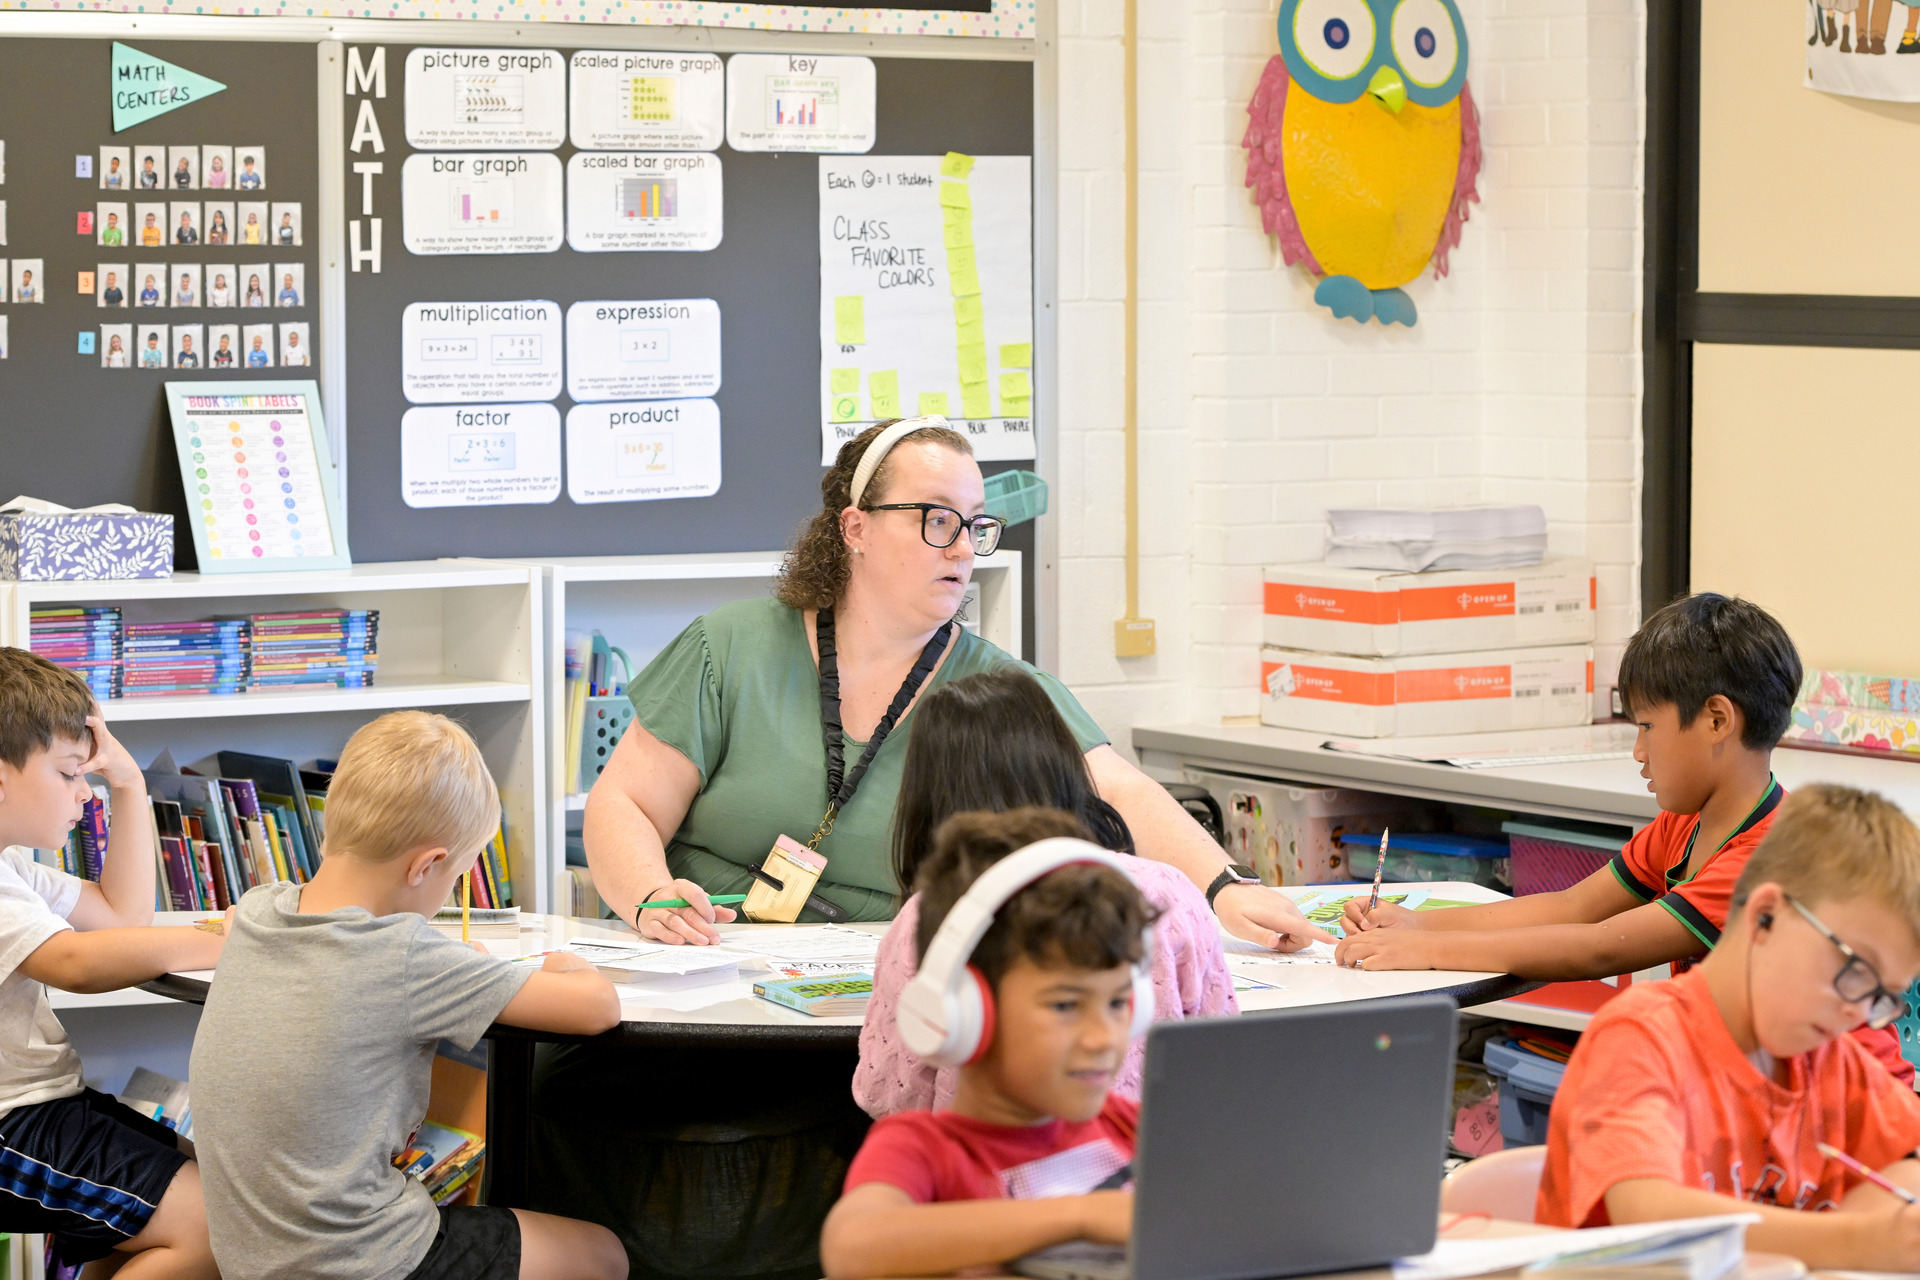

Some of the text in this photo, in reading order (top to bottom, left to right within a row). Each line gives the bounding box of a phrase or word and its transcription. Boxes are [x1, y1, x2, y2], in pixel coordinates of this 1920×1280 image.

[423, 52, 552, 73] picture graph
[574, 55, 721, 73] scaled picture graph
[789, 54, 817, 75] key
[118, 65, 166, 81] MATH
[117, 86, 190, 110] CENTERS
[346, 46, 386, 273] MATH
[433, 156, 527, 175] bar graph
[582, 156, 704, 172] scaled bar graph
[828, 172, 856, 189] Each
[887, 175, 890, 185] 1
[898, 172, 933, 187] student
[82, 218, 88, 228] 2
[834, 216, 890, 242] CLASS
[852, 246, 925, 269] FAVORITE
[83, 277, 89, 288] 3
[878, 268, 934, 289] COLORS
[420, 305, 547, 325] multiplication
[596, 304, 690, 324] expression
[83, 337, 89, 346] 4
[633, 342, 638, 350] 3
[652, 341, 657, 349] 2
[188, 394, 298, 408] BOOK SPINE LABELS
[456, 410, 510, 427] factor
[609, 407, 680, 429] product
[1004, 421, 1030, 432] PURPLE
[836, 426, 856, 438] PINK
[968, 423, 987, 434] BLUE
[468, 439, 505, 448] 2 3 6
[625, 444, 629, 453] 5
[654, 442, 663, 452] 30
